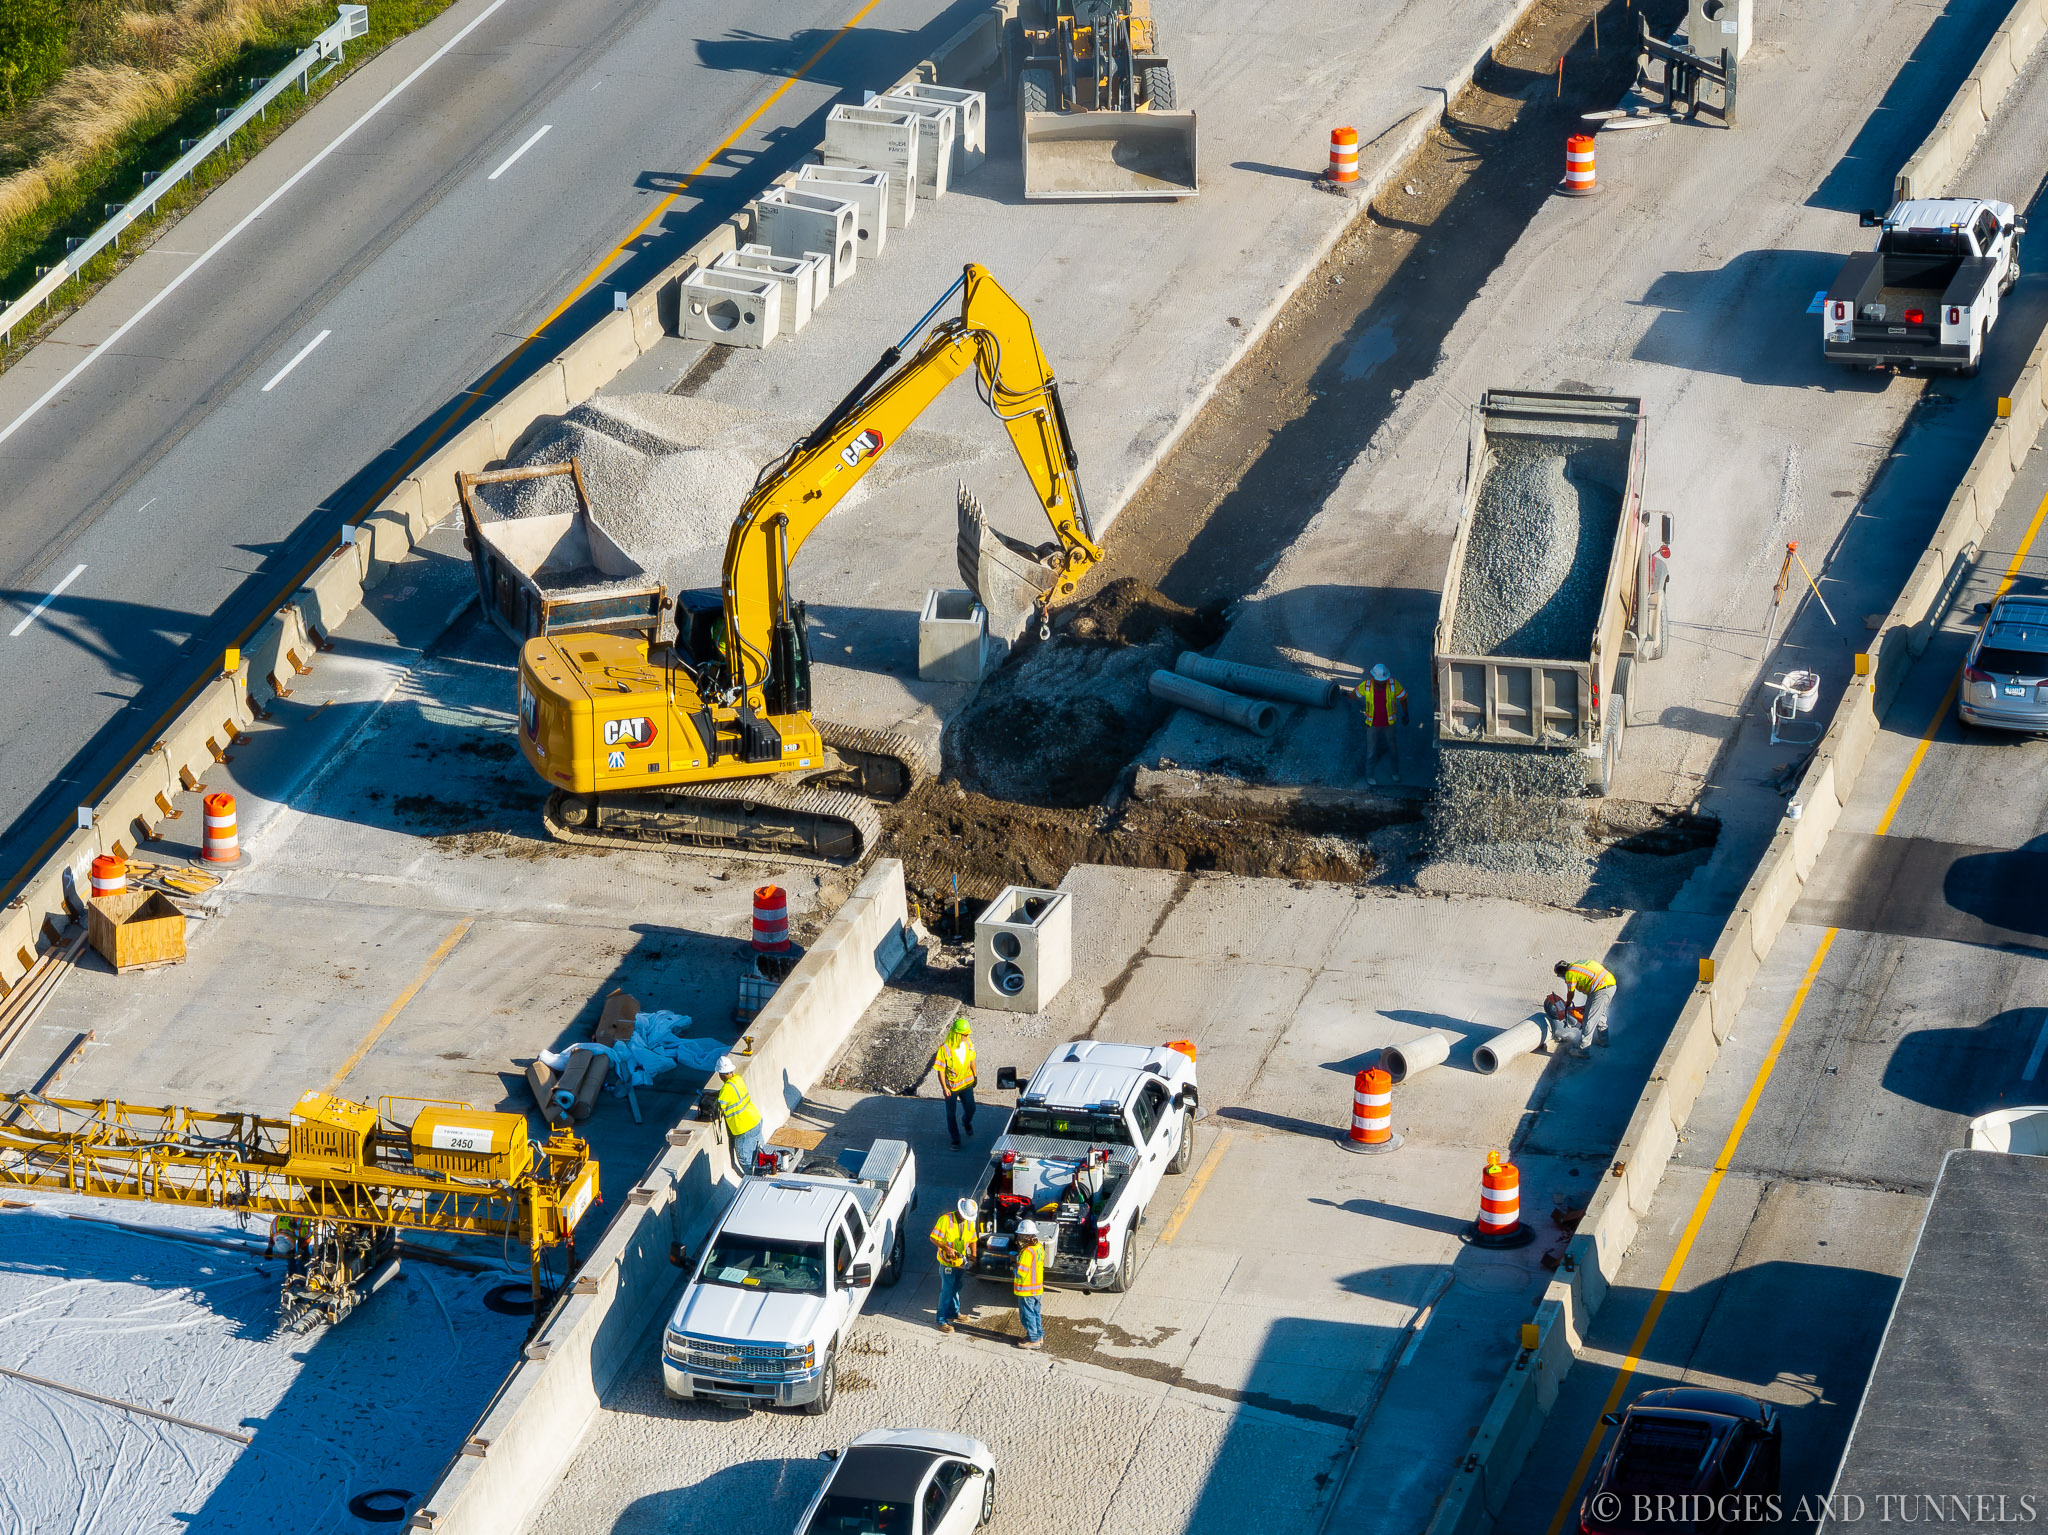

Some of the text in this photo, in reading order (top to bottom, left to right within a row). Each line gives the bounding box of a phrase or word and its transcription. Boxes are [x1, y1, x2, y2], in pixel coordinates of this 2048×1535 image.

[840, 430, 876, 468] CAT
[603, 717, 645, 746] CAT
[450, 1138, 474, 1149] 2450
